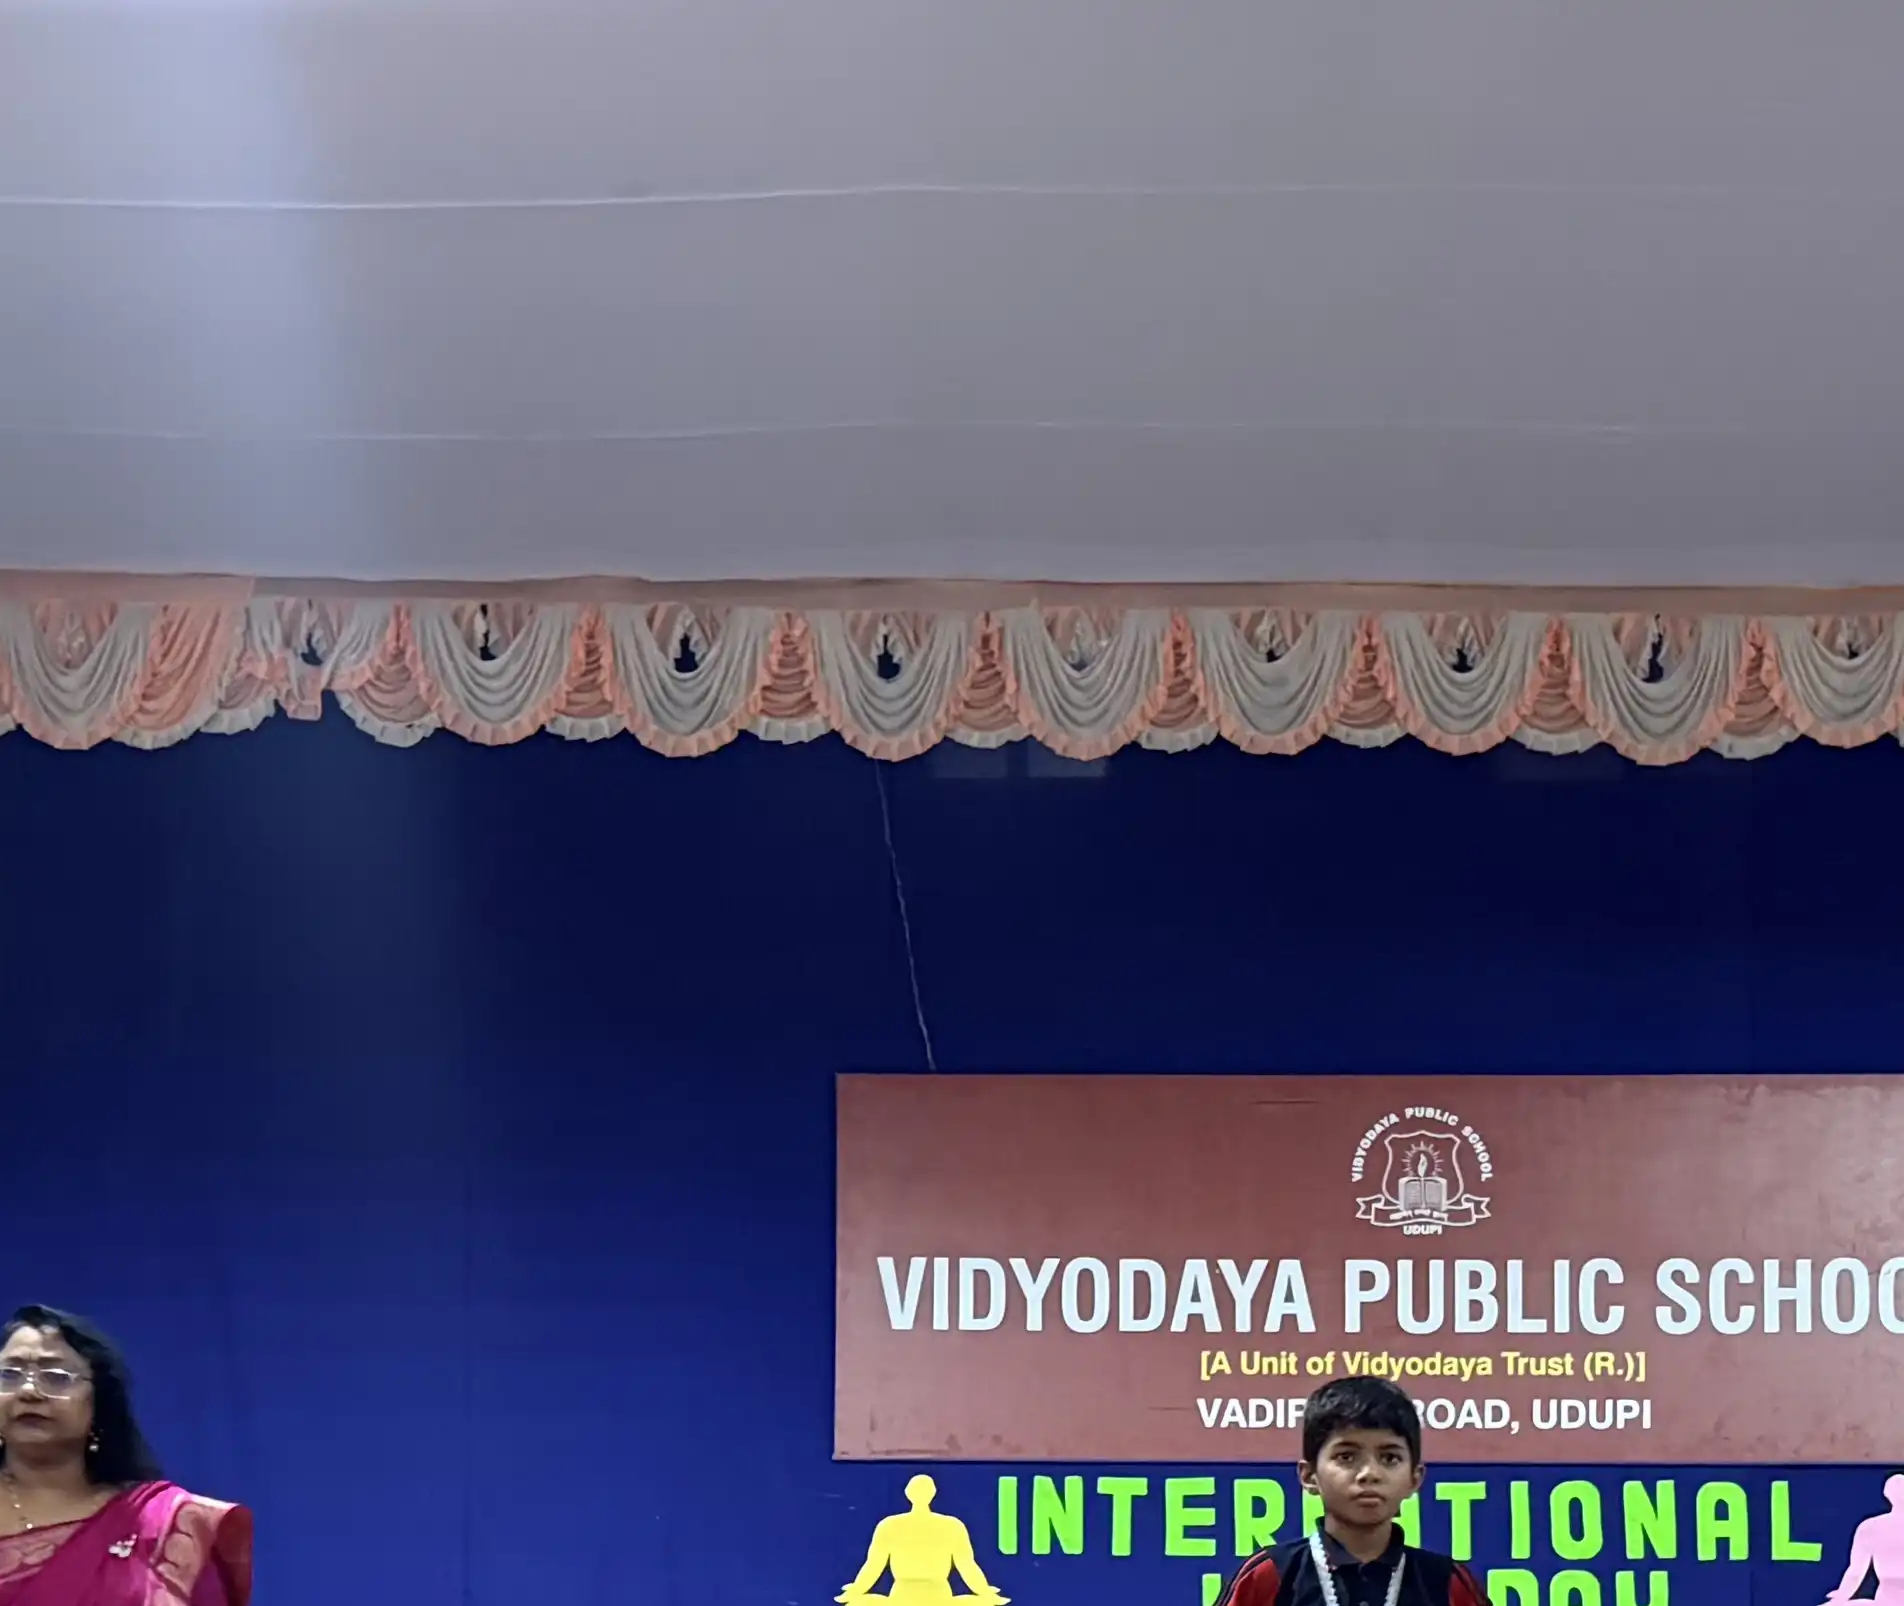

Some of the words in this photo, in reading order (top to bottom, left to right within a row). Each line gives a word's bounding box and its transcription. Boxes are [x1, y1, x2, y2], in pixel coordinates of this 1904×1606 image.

[1351, 1113, 1400, 1183] VIDYODAYA
[1404, 1106, 1459, 1127] PUBLIC
[1461, 1126, 1493, 1183] SCHOOL
[1403, 1224, 1443, 1236] UDUPI
[877, 1256, 1317, 1333] VIDYODAYA
[1344, 1257, 1625, 1335] PUBLIC
[1200, 1351, 1232, 1381] [A
[1240, 1351, 1298, 1376] Unit
[1305, 1351, 1336, 1376] of
[1342, 1351, 1493, 1382] Vidyodaya
[1501, 1352, 1574, 1376] Trust
[1583, 1352, 1647, 1383] (R.)]
[1532, 1398, 1652, 1430] UDUPI
[997, 1475, 1823, 1561] INTERTIONAL
